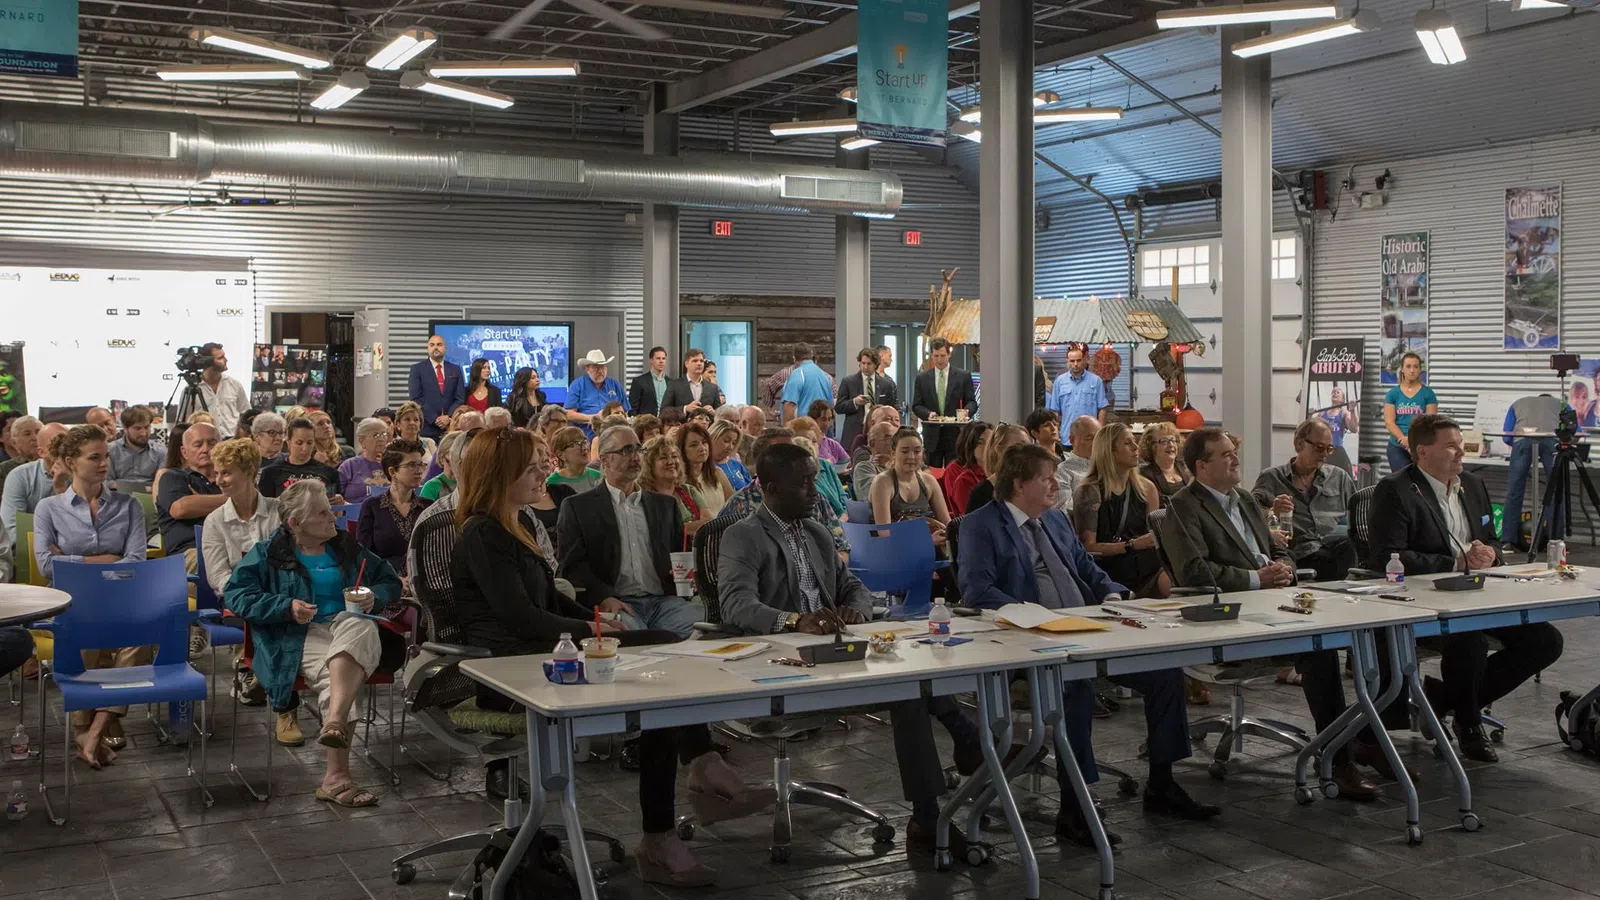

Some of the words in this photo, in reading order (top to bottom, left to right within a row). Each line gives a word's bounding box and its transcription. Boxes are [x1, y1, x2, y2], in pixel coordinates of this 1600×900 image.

[875, 69, 910, 88] Start
[1508, 194, 1560, 220] Chalmette
[715, 221, 732, 236] EXIT
[906, 231, 921, 245] EXIT
[1382, 237, 1426, 255] Historic
[1382, 259, 1398, 275] Old
[1399, 257, 1426, 274] Arabi
[484, 328, 509, 339] Start
[504, 347, 550, 374] PARTY
